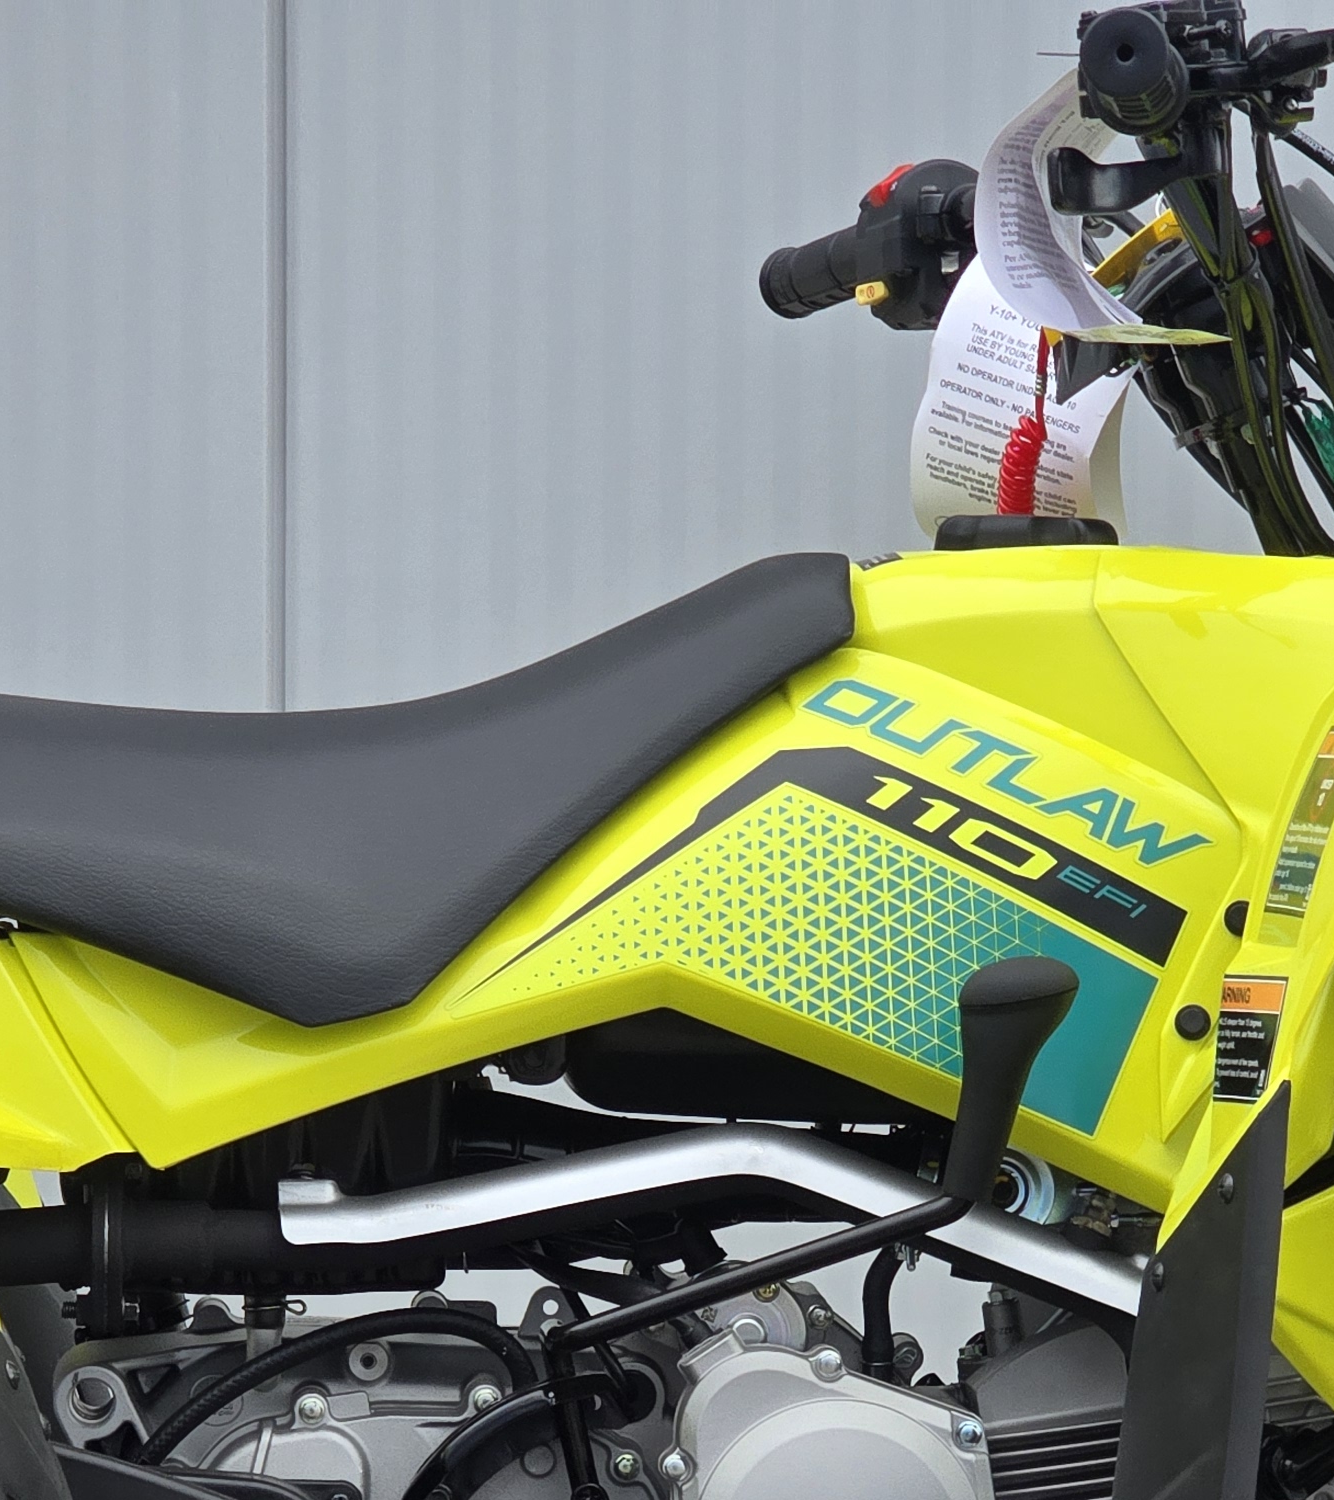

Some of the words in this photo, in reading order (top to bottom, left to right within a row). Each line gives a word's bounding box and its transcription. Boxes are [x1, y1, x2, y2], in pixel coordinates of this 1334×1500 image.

[989, 304, 1018, 323] Y-10+
[970, 322, 988, 335] This
[988, 329, 1007, 341] ATV
[1006, 334, 1015, 344] is
[1015, 338, 1029, 349] for
[971, 334, 989, 347] USE
[989, 340, 1002, 351] BY
[1003, 345, 1034, 362] YOUNG
[965, 343, 995, 360] UNDER
[995, 353, 1024, 370] ADULT
[939, 378, 983, 400] OPERATOR
[983, 394, 1005, 408] ONLY
[1010, 403, 1023, 414] NO
[956, 362, 970, 373] NO
[970, 367, 1014, 388] OPERATOR
[1066, 400, 1076, 410] 10
[800, 679, 1215, 867] OUTLAW
[865, 775, 1057, 880] 110
[1057, 864, 1148, 919] EFI
[1222, 986, 1251, 1004] ARNING
